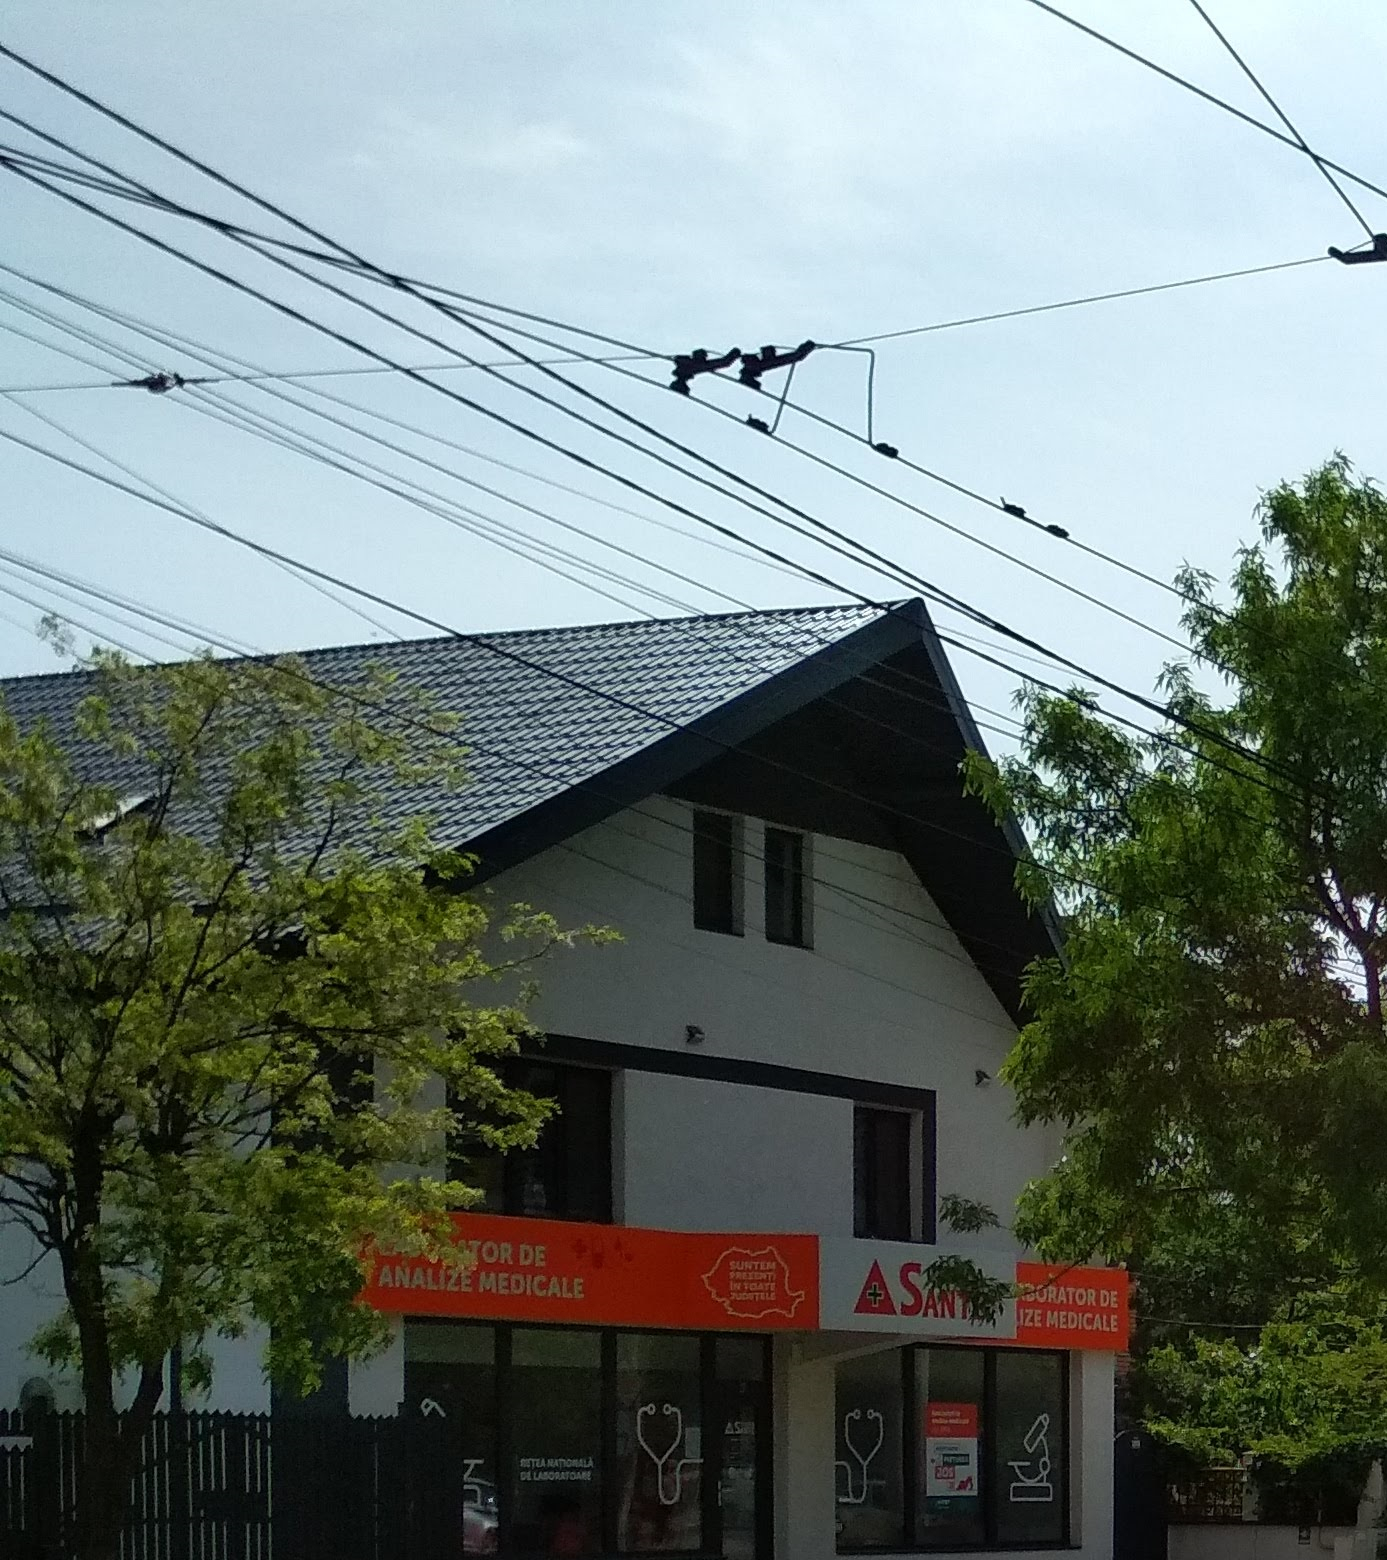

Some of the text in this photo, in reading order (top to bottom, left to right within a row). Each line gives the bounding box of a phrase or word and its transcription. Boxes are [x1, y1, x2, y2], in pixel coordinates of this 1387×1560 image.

[519, 1243, 546, 1267] DE
[378, 1264, 585, 1299] ANALIZE MEDICALE
[1100, 1290, 1118, 1308] DE
[1046, 1310, 1118, 1332] MEDICALE
